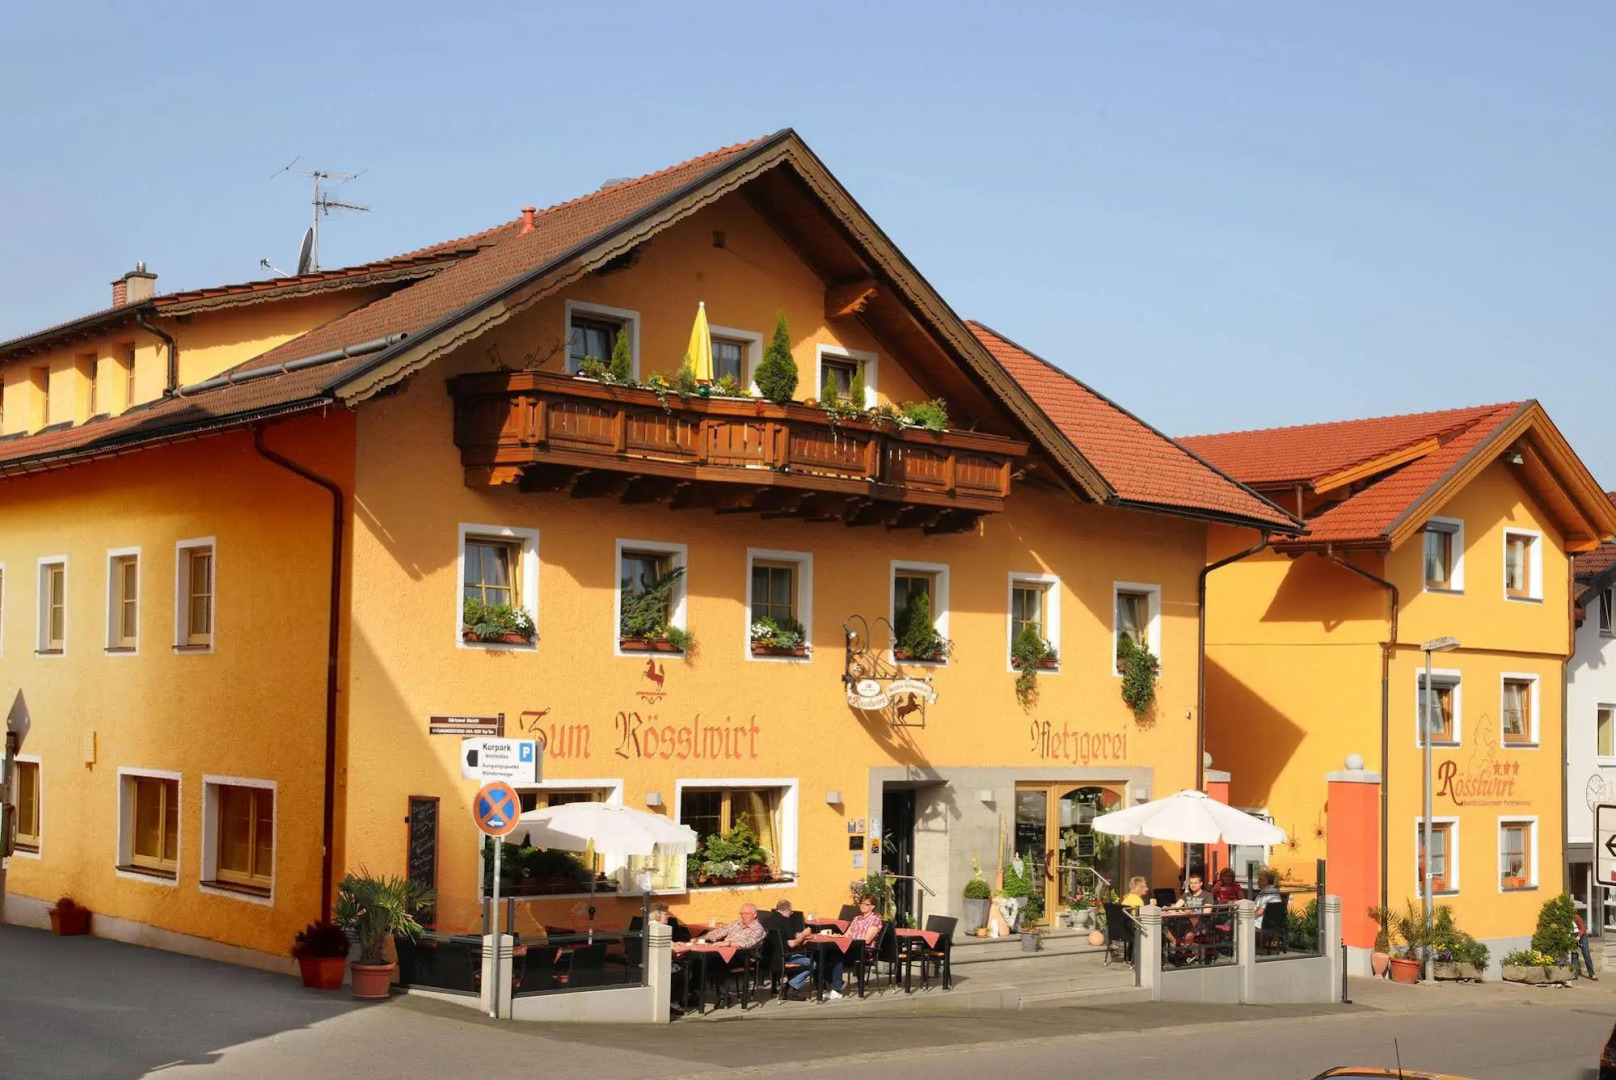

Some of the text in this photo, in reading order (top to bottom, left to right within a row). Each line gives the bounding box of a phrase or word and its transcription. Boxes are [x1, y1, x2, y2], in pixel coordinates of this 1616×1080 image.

[482, 743, 511, 752] Kurpark
[519, 707, 760, 760] Zum Rösslwirt
[1030, 719, 1127, 765] Metzgerei
[1436, 760, 1515, 806] Rösslwirt
